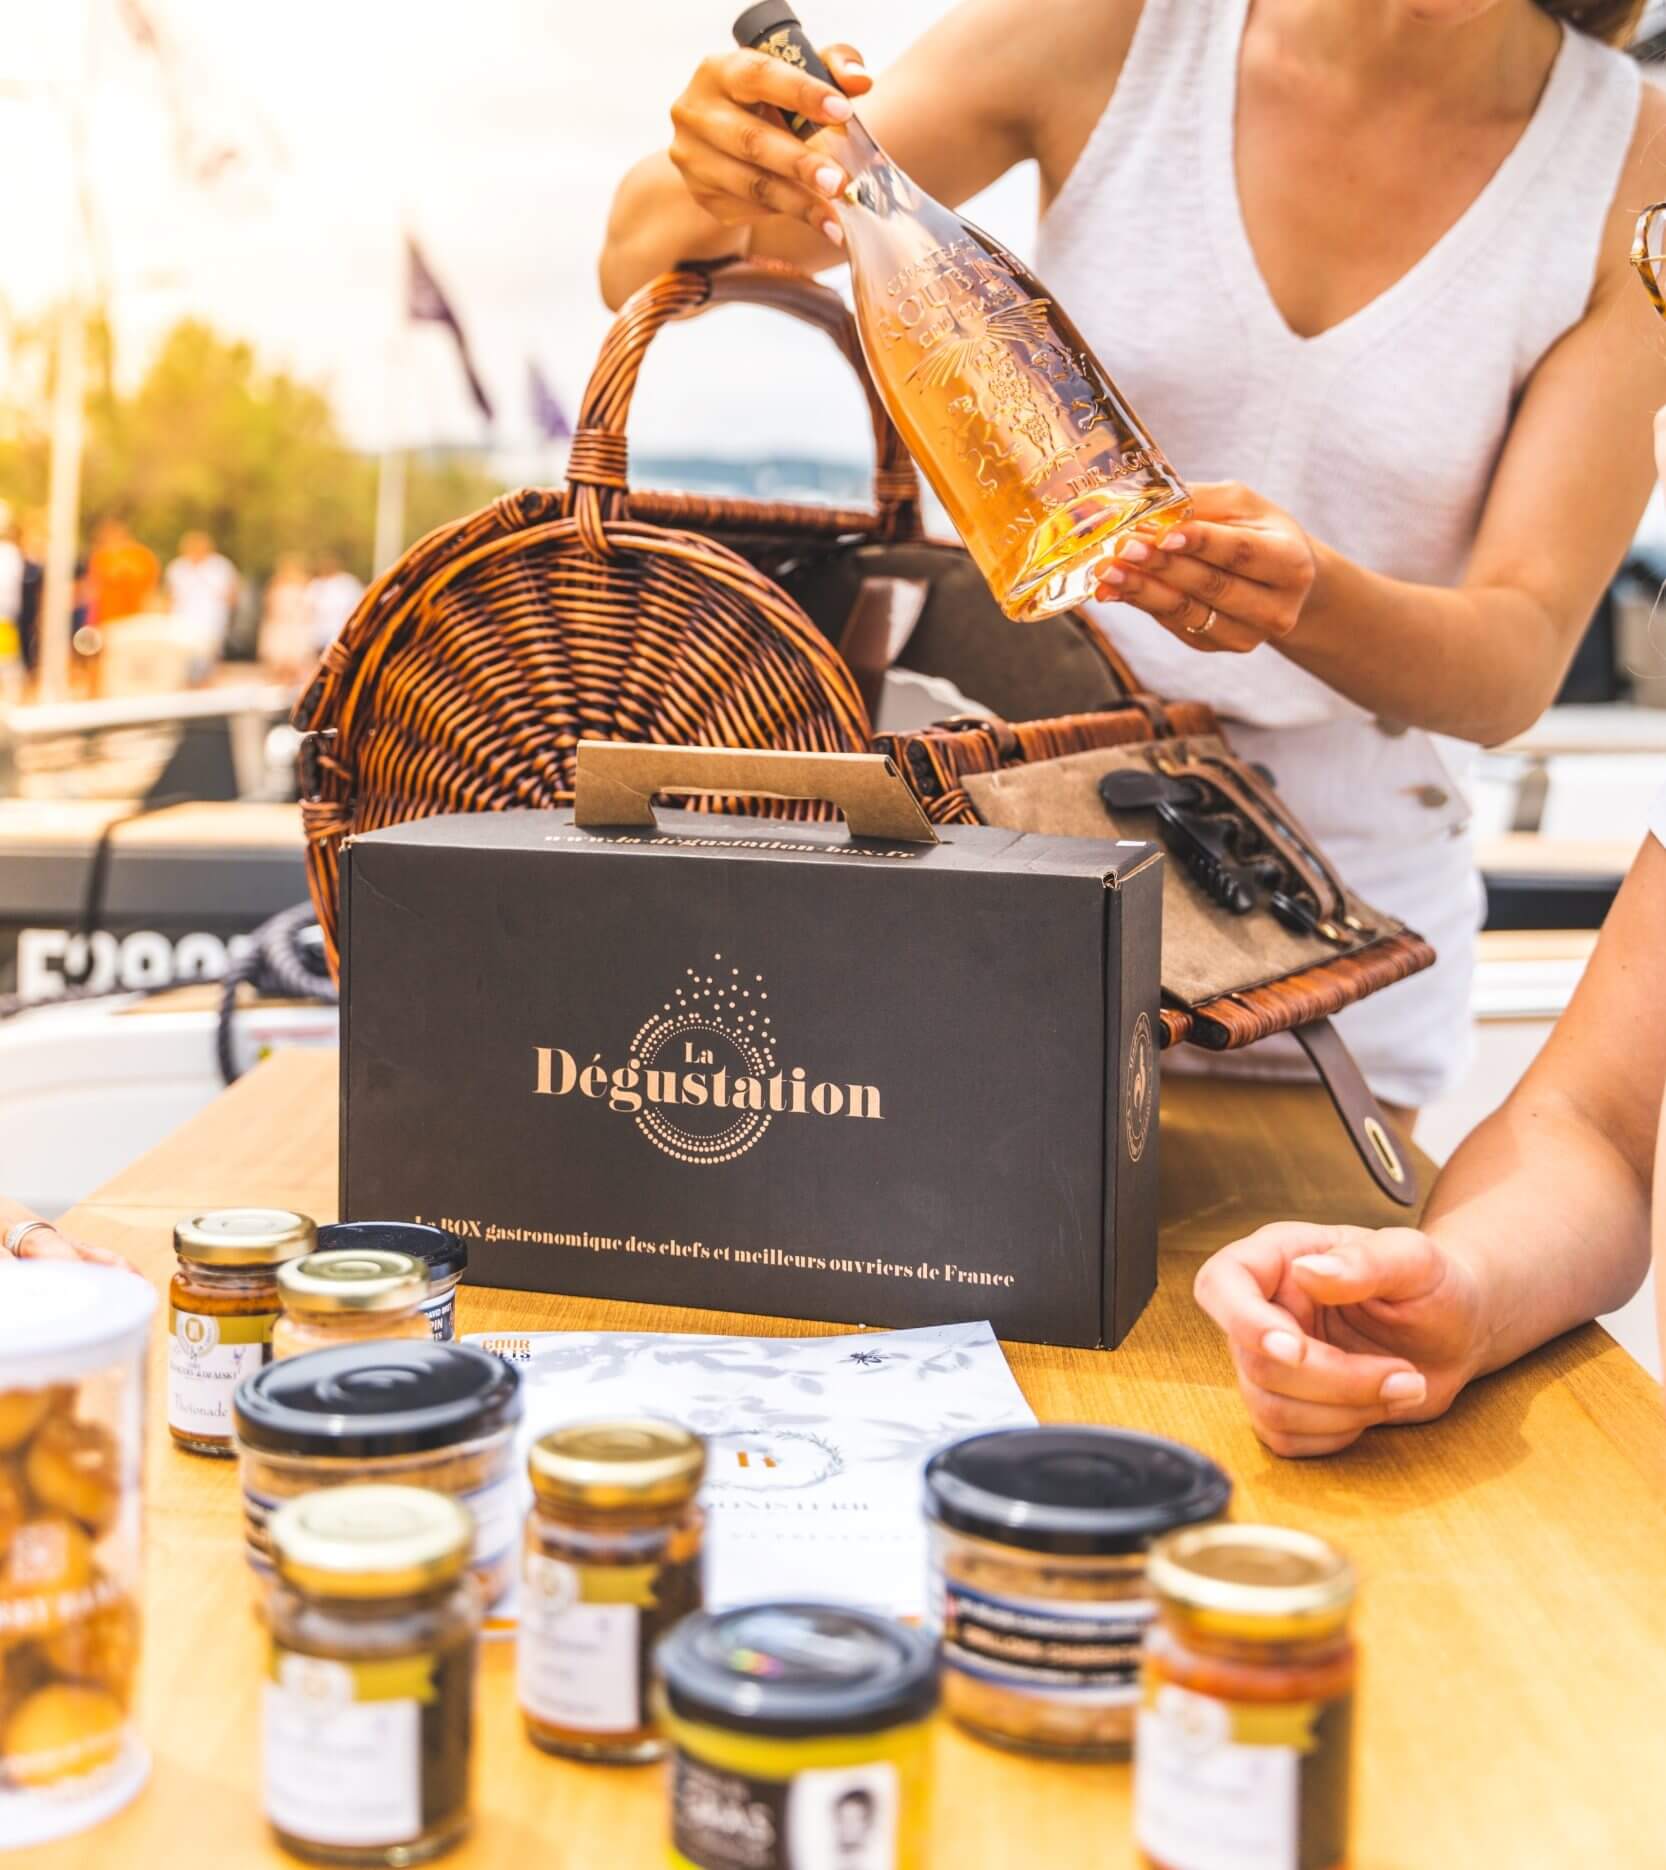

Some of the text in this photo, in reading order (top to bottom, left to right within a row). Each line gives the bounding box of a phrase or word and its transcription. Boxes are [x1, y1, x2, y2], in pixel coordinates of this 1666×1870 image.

[531, 1046, 886, 1120] Dégustation
[684, 1041, 714, 1065] La
[441, 1217, 483, 1238] BOX
[484, 1223, 623, 1252] gastronomique
[625, 1235, 656, 1255] des
[659, 1239, 711, 1260] chefs
[713, 1245, 730, 1262] et
[734, 1248, 827, 1270] meilleurs
[829, 1258, 914, 1279] ouvriers
[916, 1262, 941, 1281] de
[943, 1264, 1016, 1288] France
